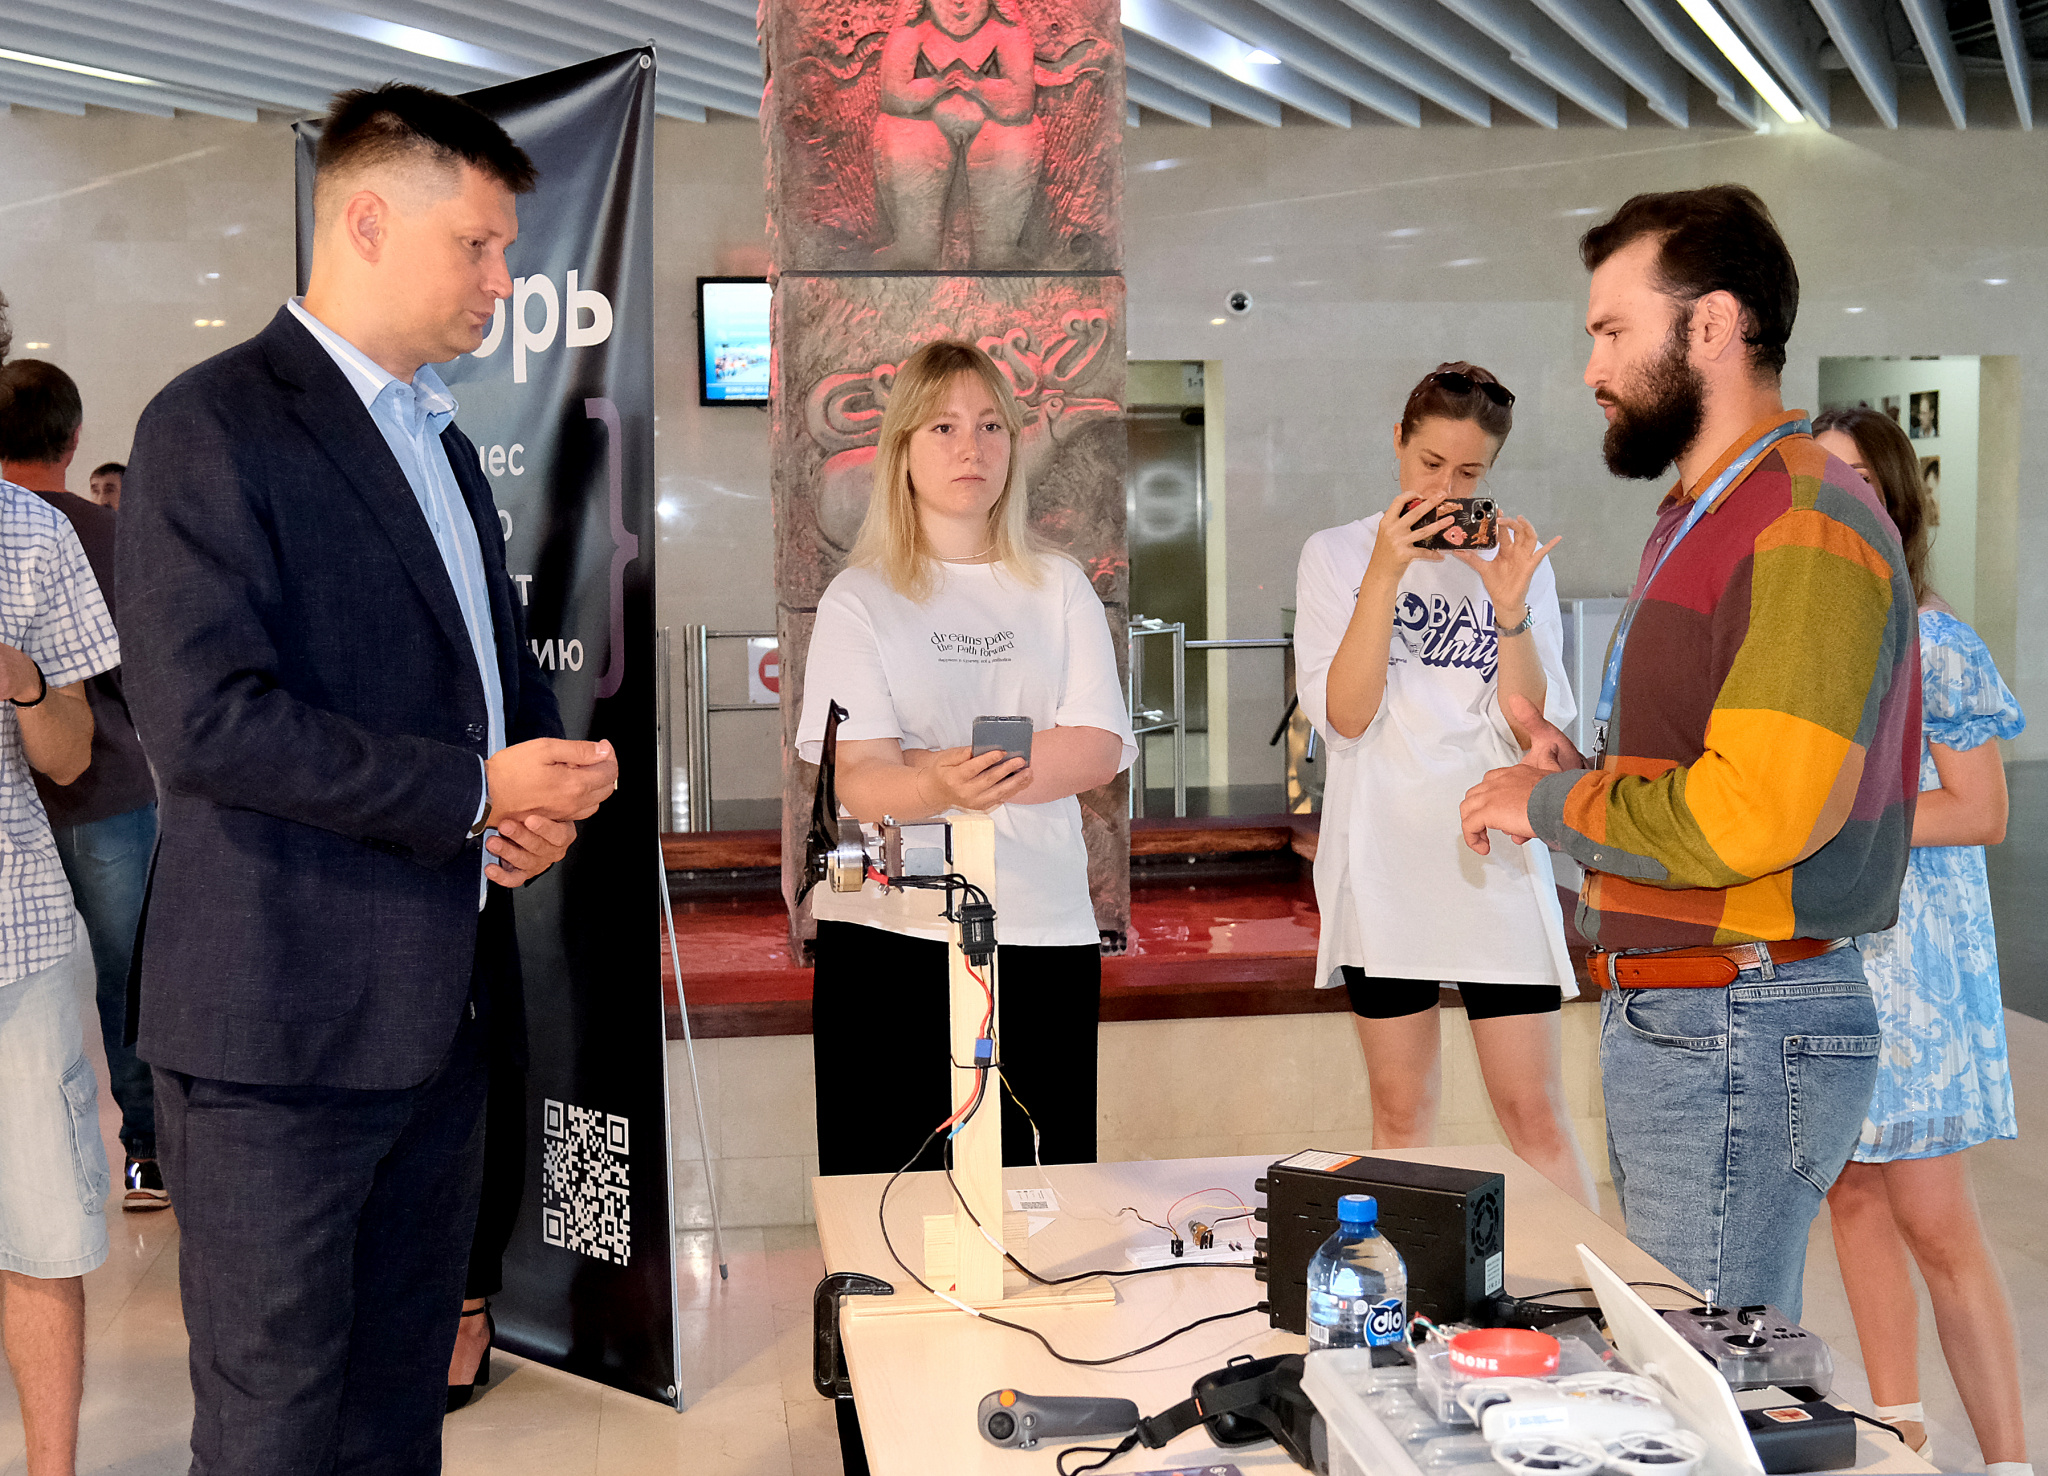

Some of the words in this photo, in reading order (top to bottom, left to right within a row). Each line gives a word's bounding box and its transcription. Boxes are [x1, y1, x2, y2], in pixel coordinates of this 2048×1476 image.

[930, 631, 982, 646] dreams
[984, 630, 1015, 650] pave
[936, 643, 953, 652] the
[957, 644, 977, 656] path
[980, 641, 1015, 657] forward
[1450, 1349, 1499, 1371] DRONE
